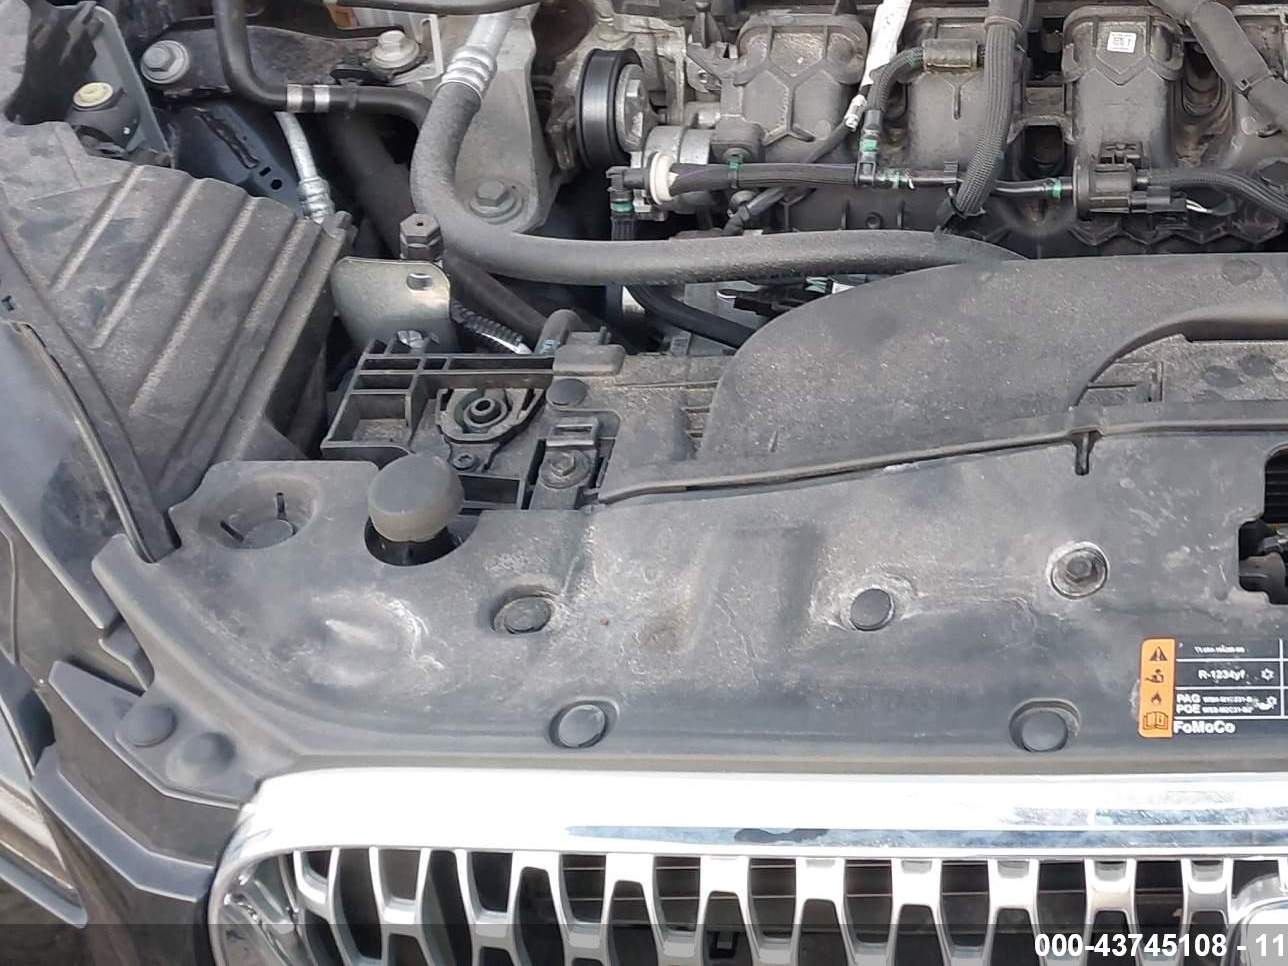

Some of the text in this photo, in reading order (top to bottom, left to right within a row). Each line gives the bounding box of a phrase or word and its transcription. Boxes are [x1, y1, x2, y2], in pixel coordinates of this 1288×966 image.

[1197, 669, 1246, 681] R-1234yf
[1176, 694, 1201, 703] PAG
[1176, 704, 1201, 714] POE
[1173, 720, 1236, 734] FoMoCo
